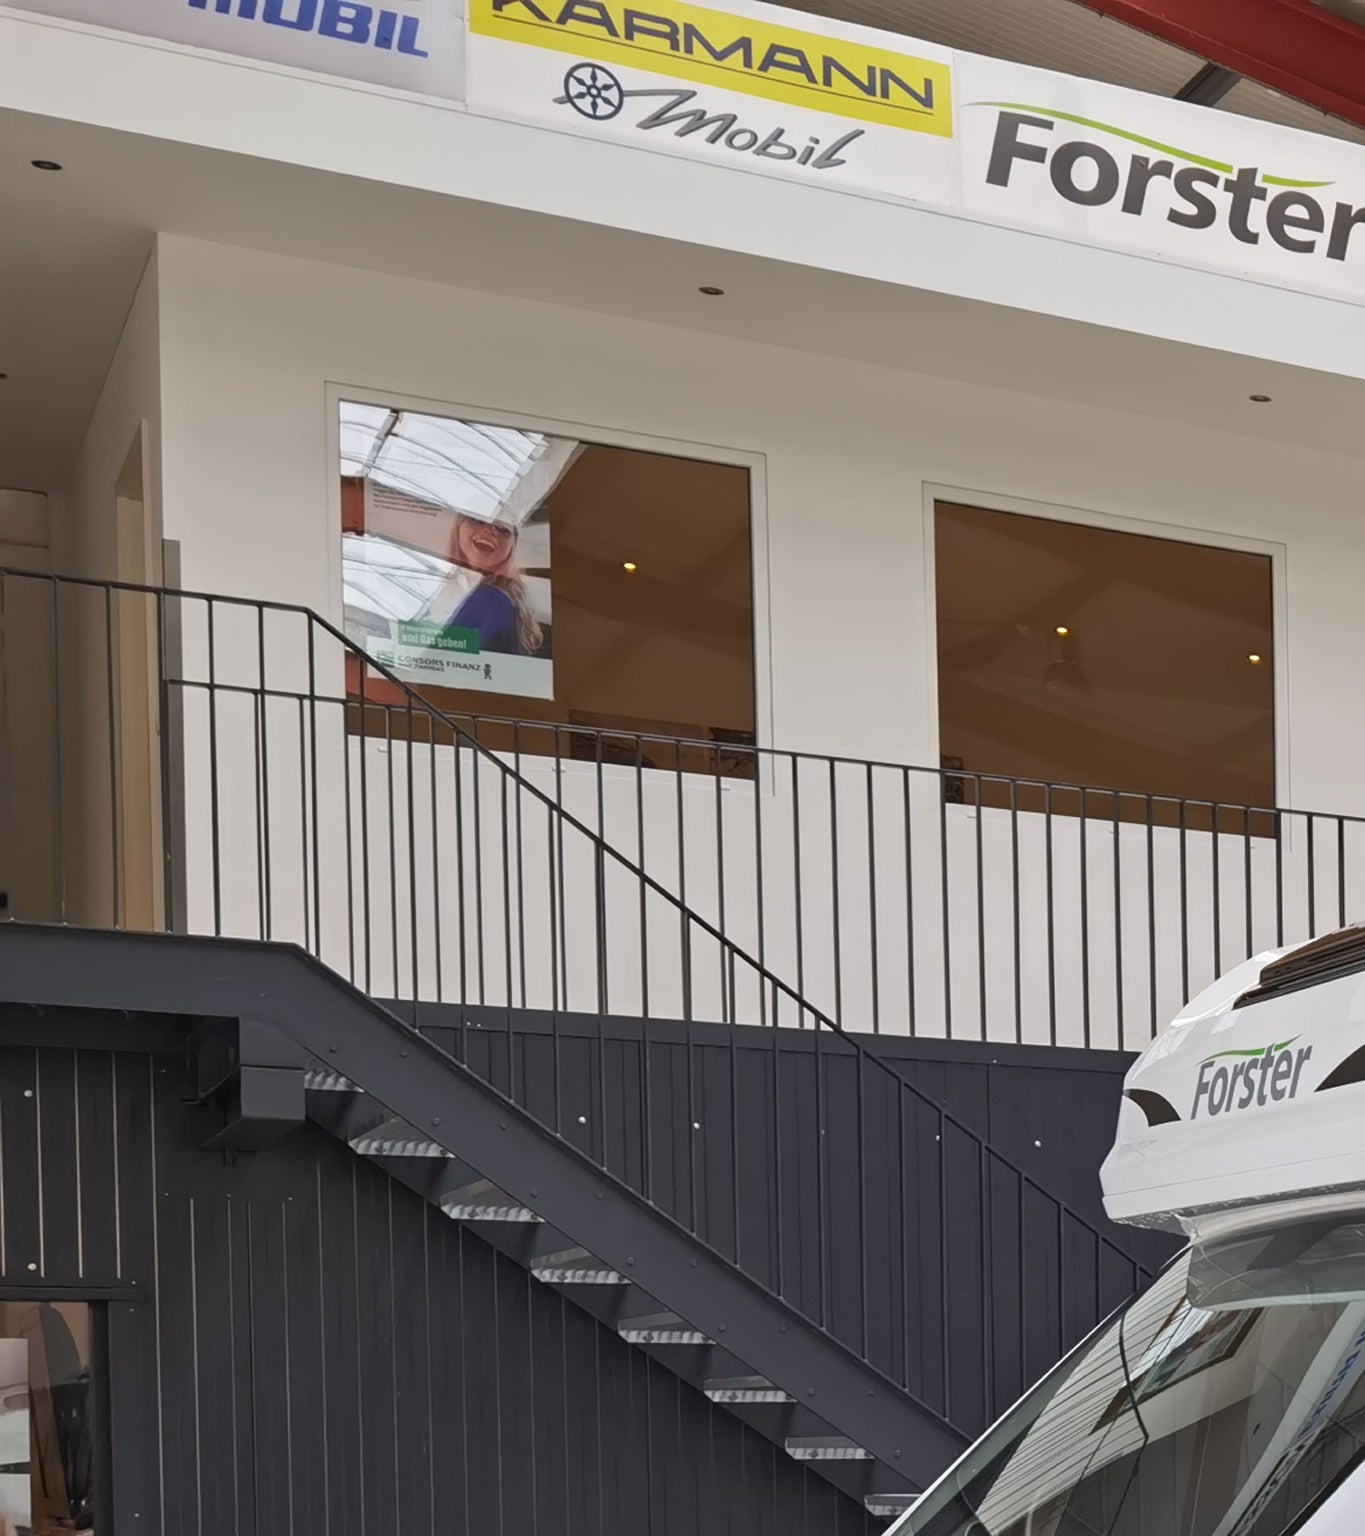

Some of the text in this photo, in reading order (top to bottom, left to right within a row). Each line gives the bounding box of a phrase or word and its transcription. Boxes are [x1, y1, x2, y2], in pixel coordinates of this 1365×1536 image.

[628, 88, 866, 169] Mobil
[446, 660, 481, 672] FINANZ
[1190, 1042, 1313, 1121] Forster
